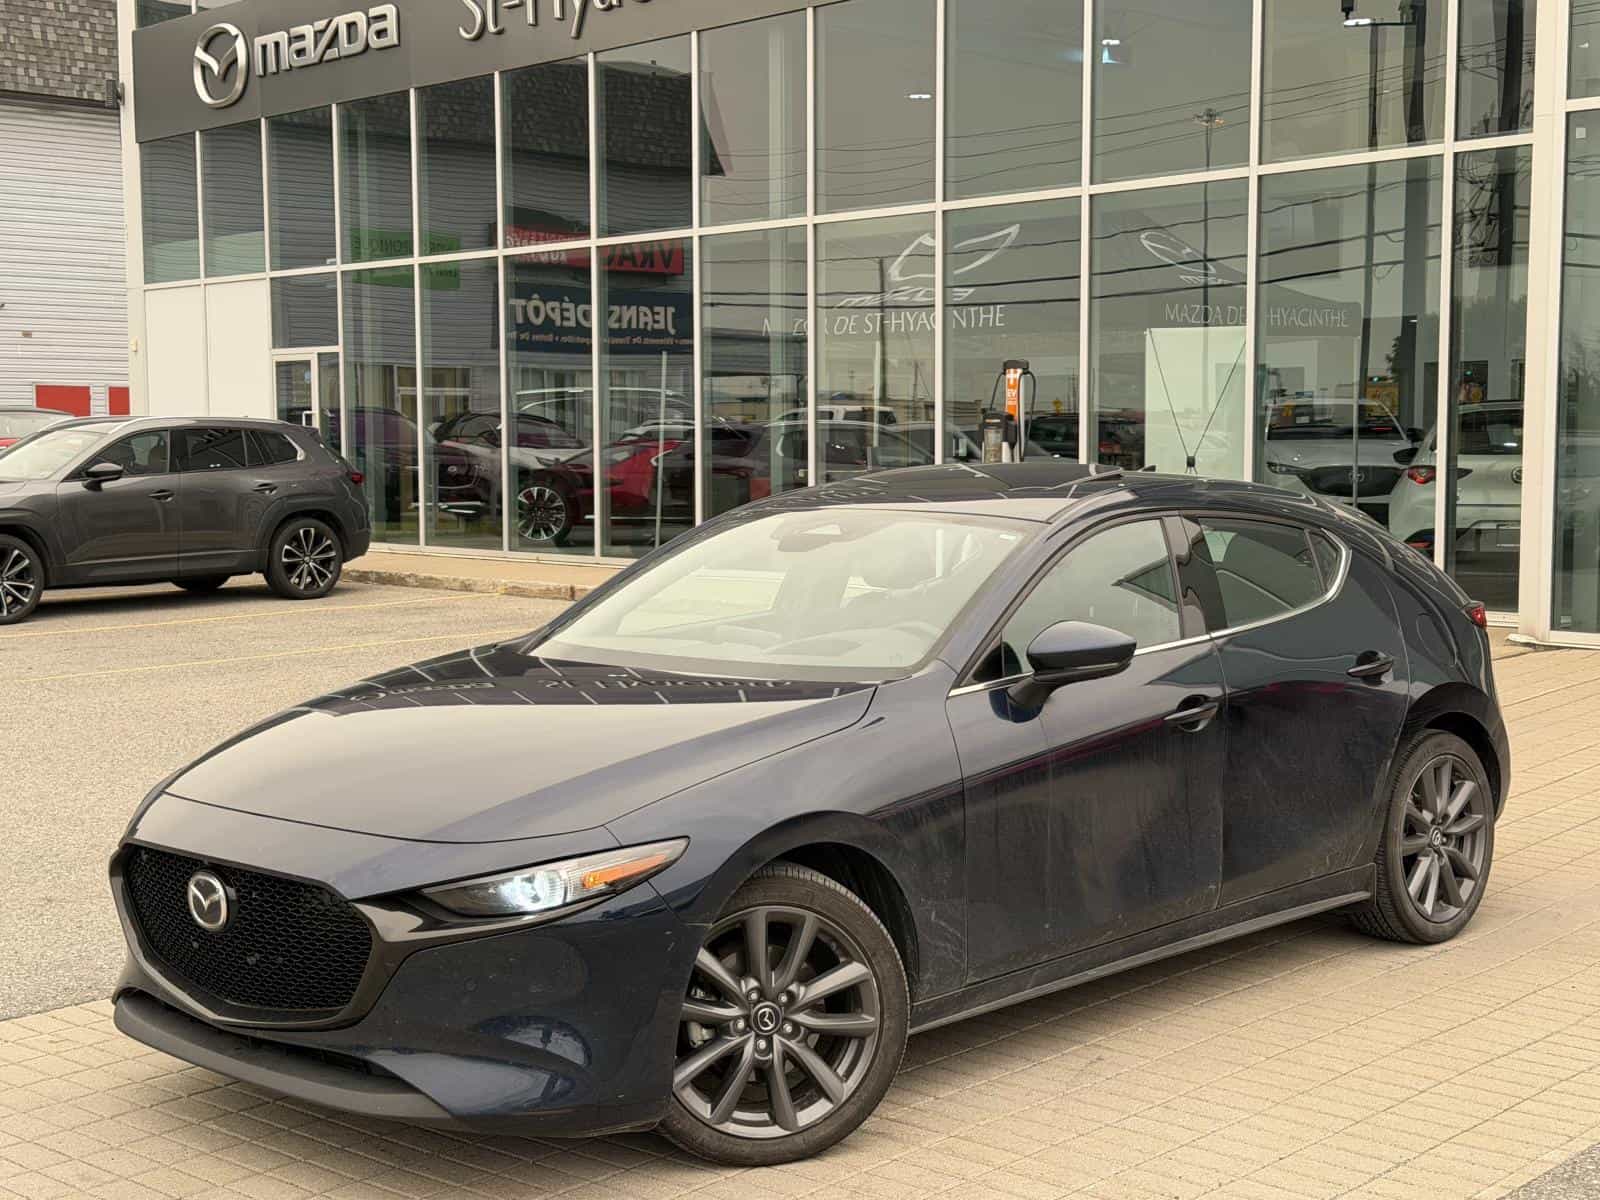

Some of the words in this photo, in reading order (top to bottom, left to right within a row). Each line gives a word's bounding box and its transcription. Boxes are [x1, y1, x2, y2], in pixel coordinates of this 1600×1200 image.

[253, 3, 399, 77] mazda
[833, 314, 860, 336] DE
[863, 304, 1006, 334] ST-HYACNTHE
[1163, 303, 1223, 325] MAZDA
